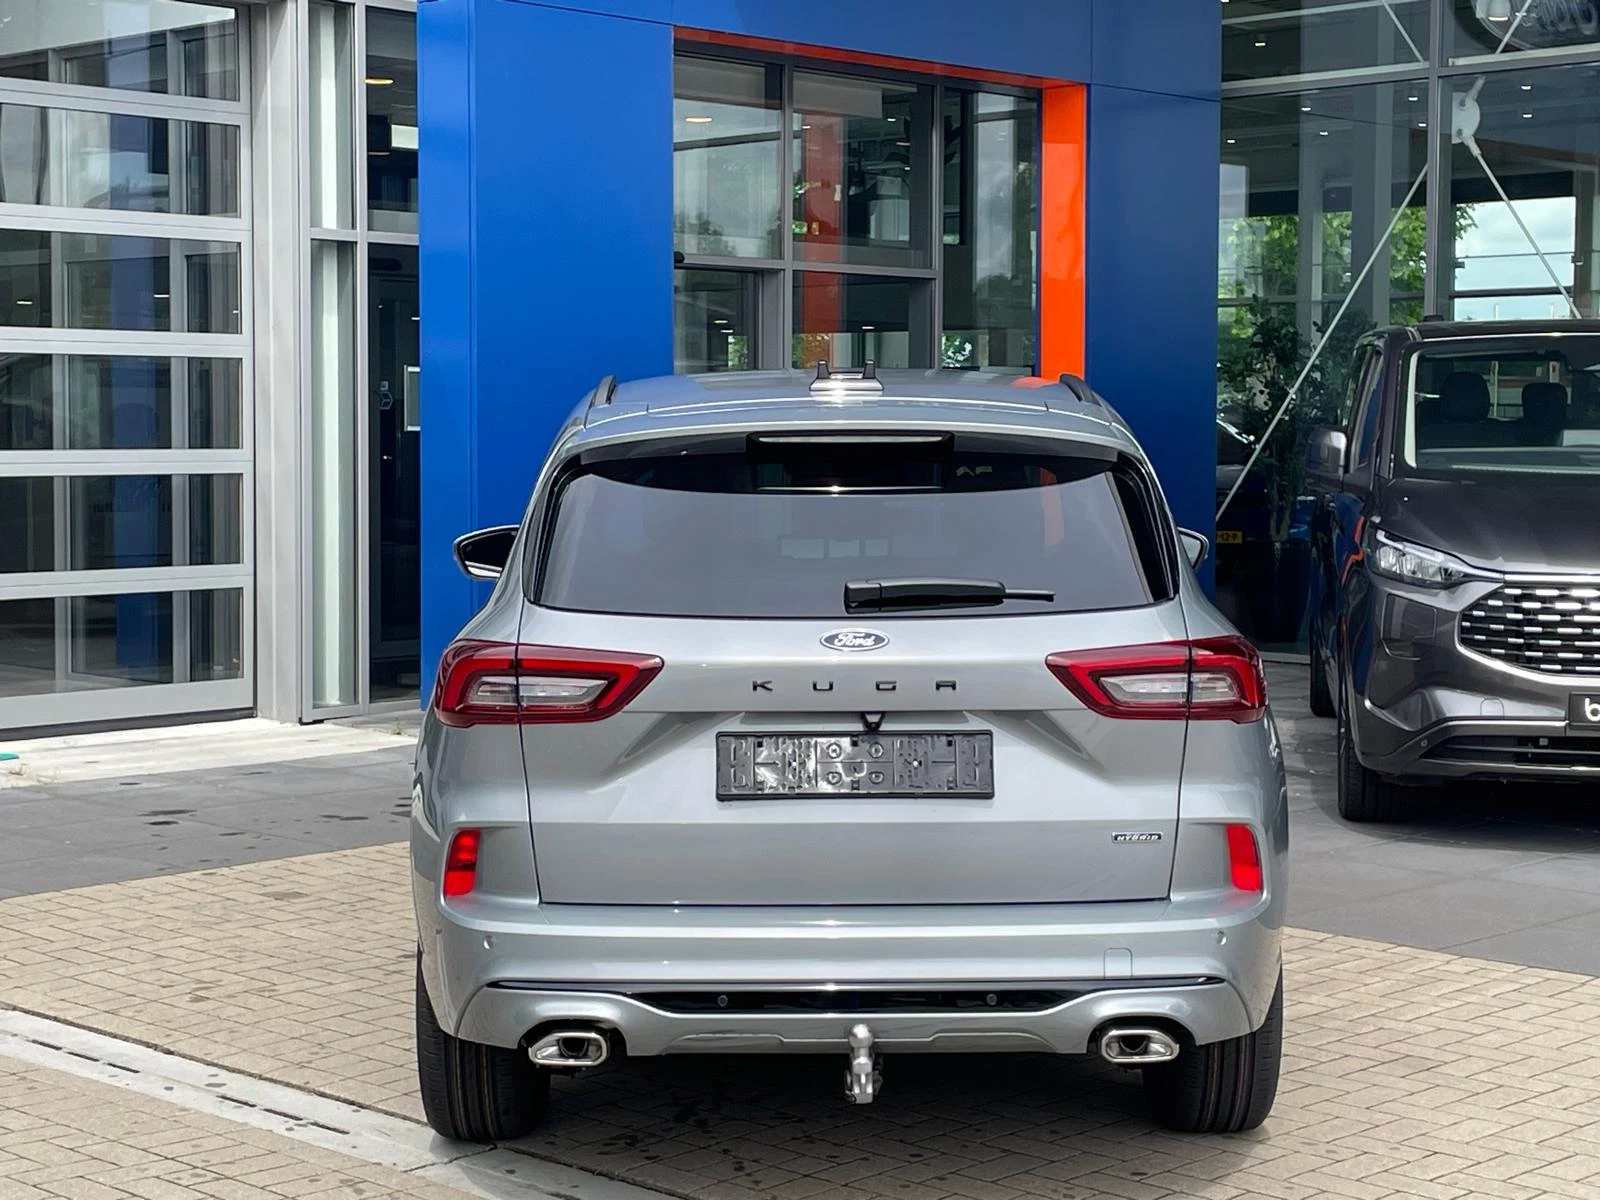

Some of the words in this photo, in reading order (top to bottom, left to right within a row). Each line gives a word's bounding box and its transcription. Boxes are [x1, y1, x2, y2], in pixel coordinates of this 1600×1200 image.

[834, 632, 876, 646] Ford
[752, 680, 957, 692] KUGA
[1116, 833, 1160, 841] HYBRID
